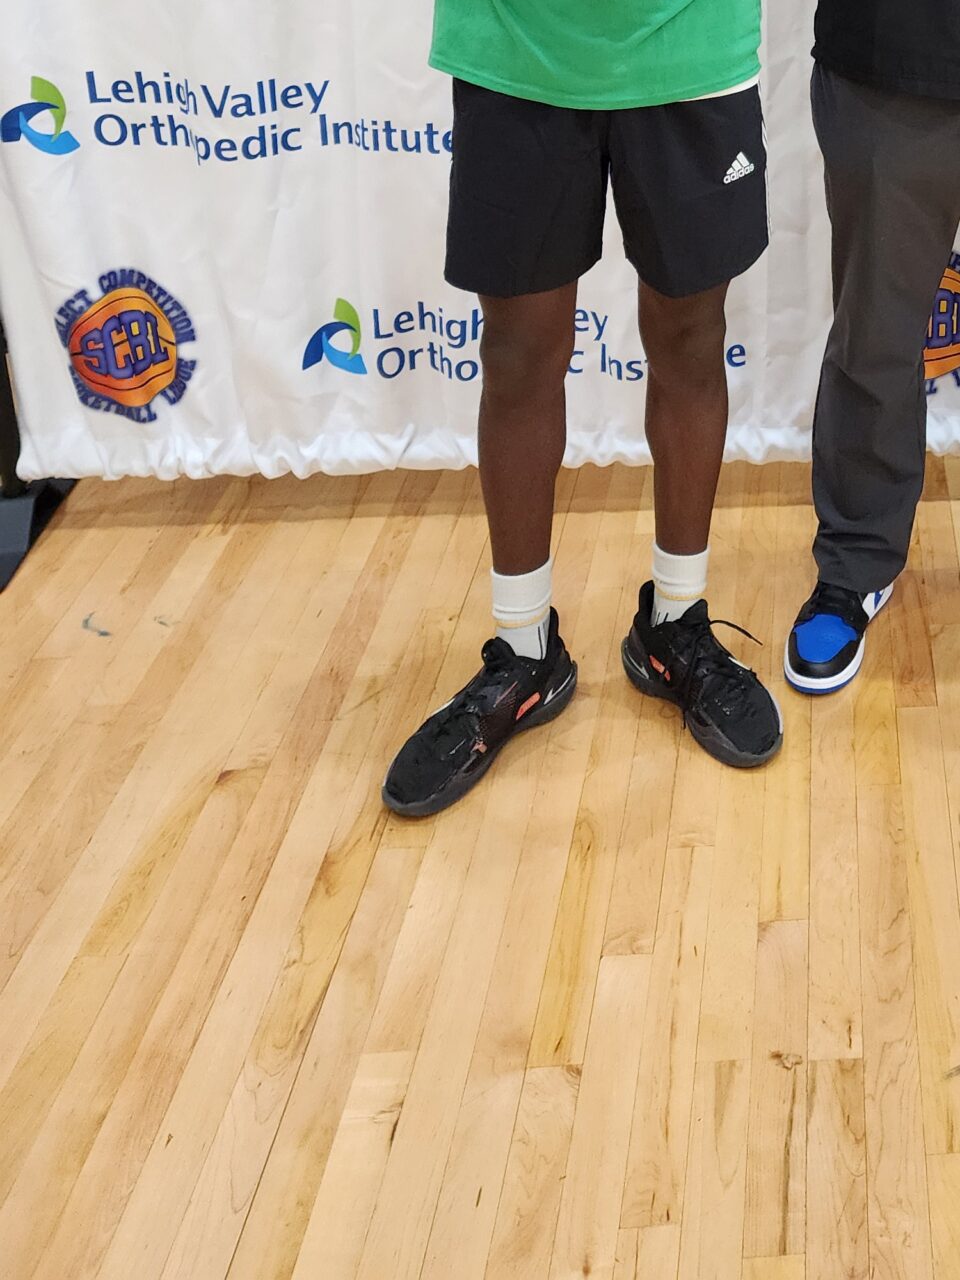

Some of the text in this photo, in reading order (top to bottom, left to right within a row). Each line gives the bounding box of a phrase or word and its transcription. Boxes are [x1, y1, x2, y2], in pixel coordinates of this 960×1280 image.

[85, 71, 329, 118] Lehigh Valley
[94, 114, 301, 165] Orthpedic
[723, 163, 754, 184] adidas
[98, 269, 196, 344] COMPETITION
[81, 309, 169, 379] SCBL
[376, 342, 478, 382] Ortho
